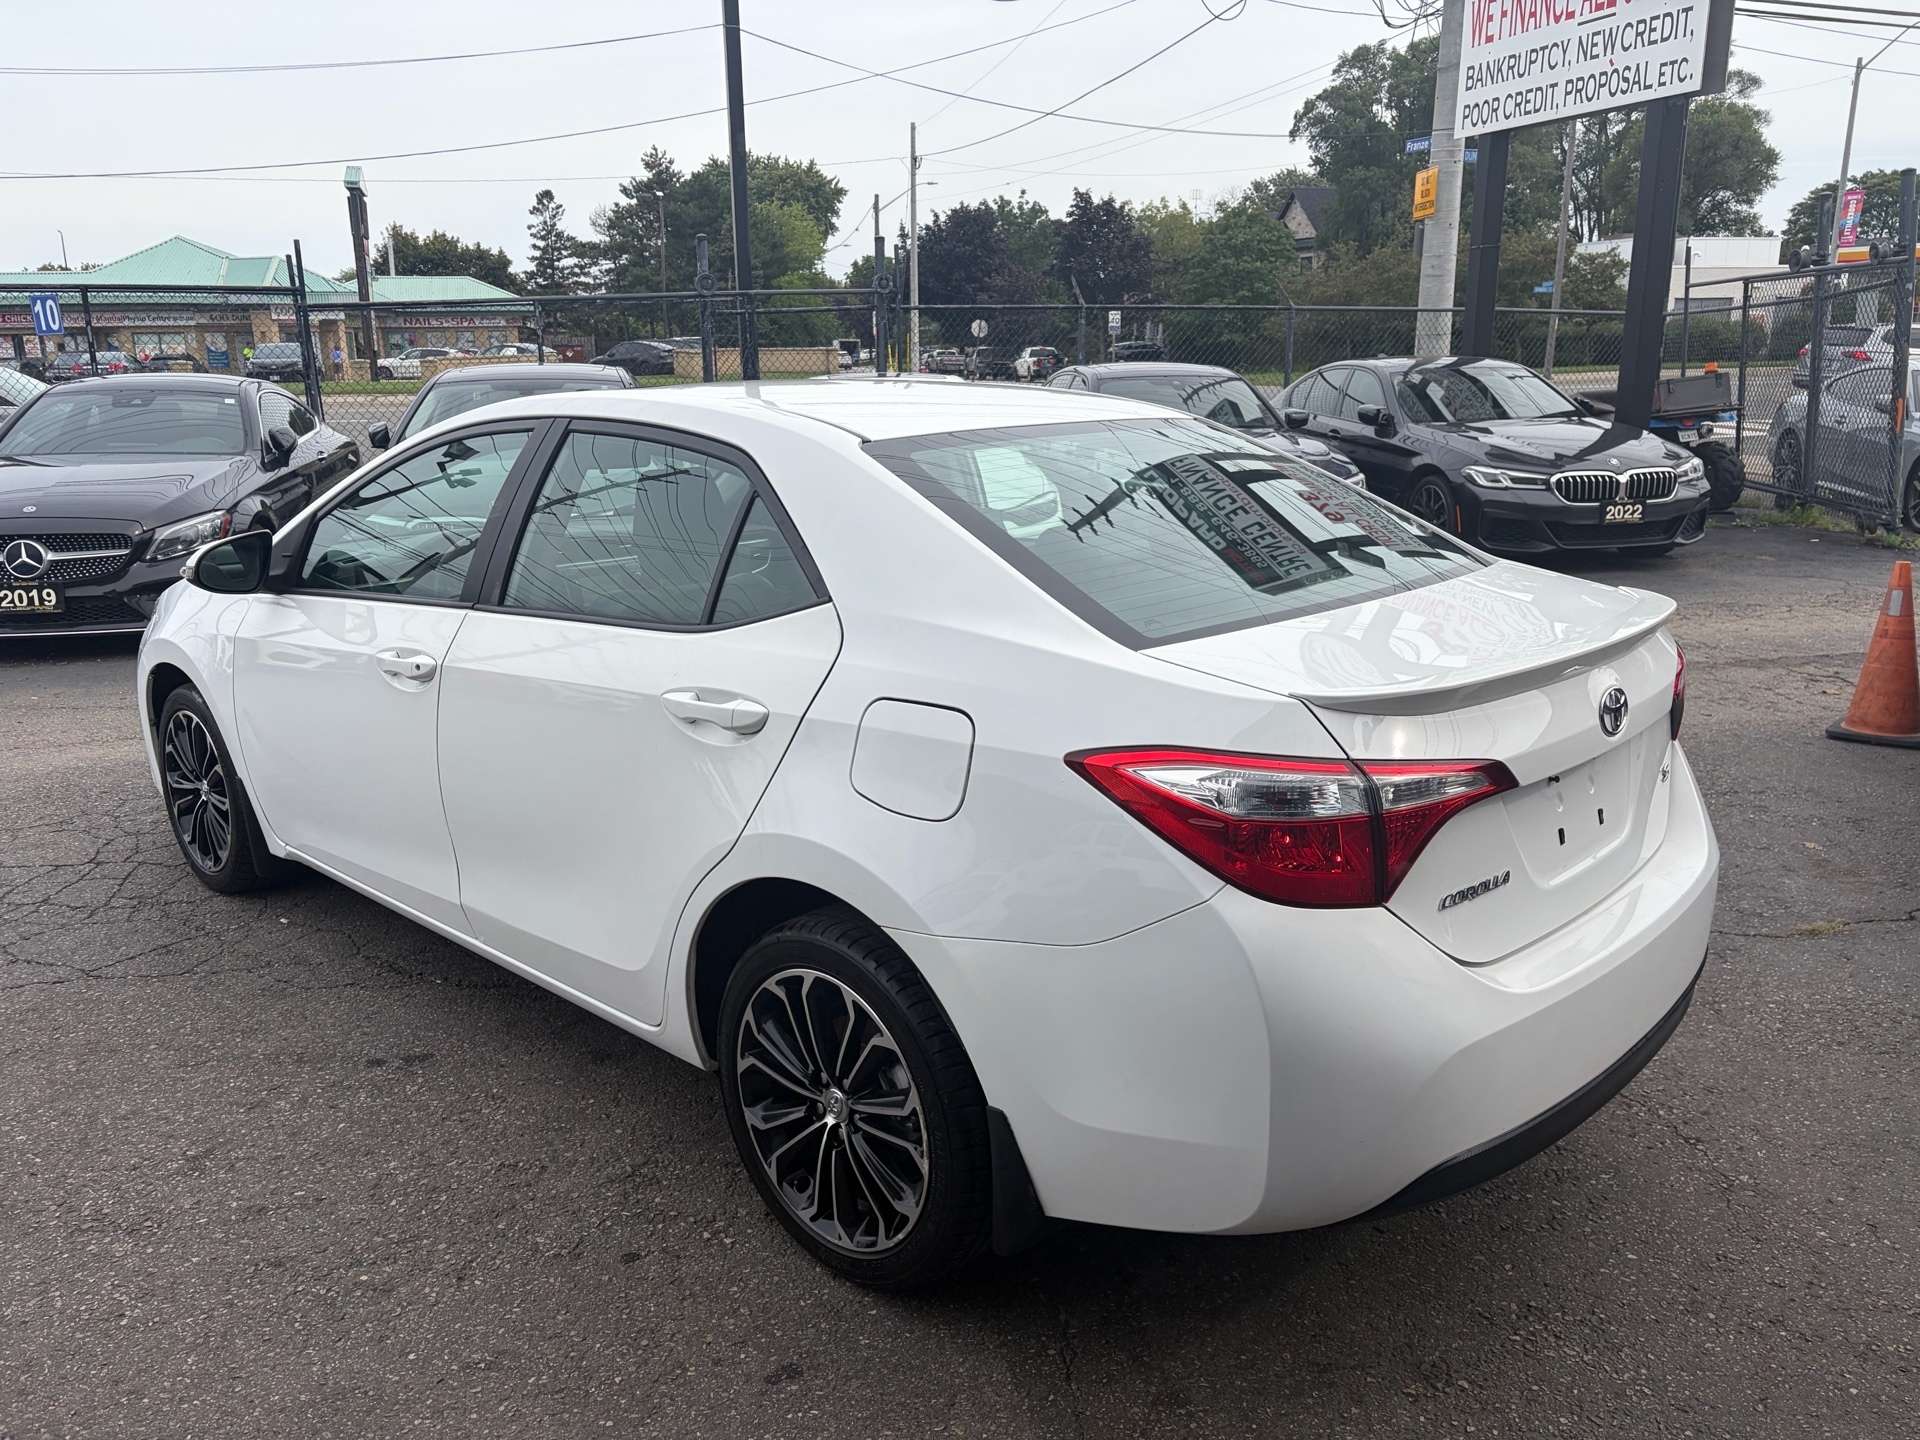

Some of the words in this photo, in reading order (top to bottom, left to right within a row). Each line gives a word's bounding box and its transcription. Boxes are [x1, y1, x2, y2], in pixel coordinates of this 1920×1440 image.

[1472, 0, 1495, 48] WE
[1465, 38, 1572, 92] BANKRUPTCY,
[1576, 25, 1620, 65] NEW
[1620, 6, 1695, 53] CREDIT,
[1461, 96, 1500, 130] POOR
[1502, 82, 1559, 120] CREDIT,
[1658, 57, 1694, 89] ETC.
[34, 299, 60, 331] 10
[403, 316, 444, 326] NAILS
[451, 316, 477, 326] SPA
[1605, 504, 1643, 519] 2022
[0, 588, 57, 607] 2019
[1437, 869, 1511, 912] COROLLA
